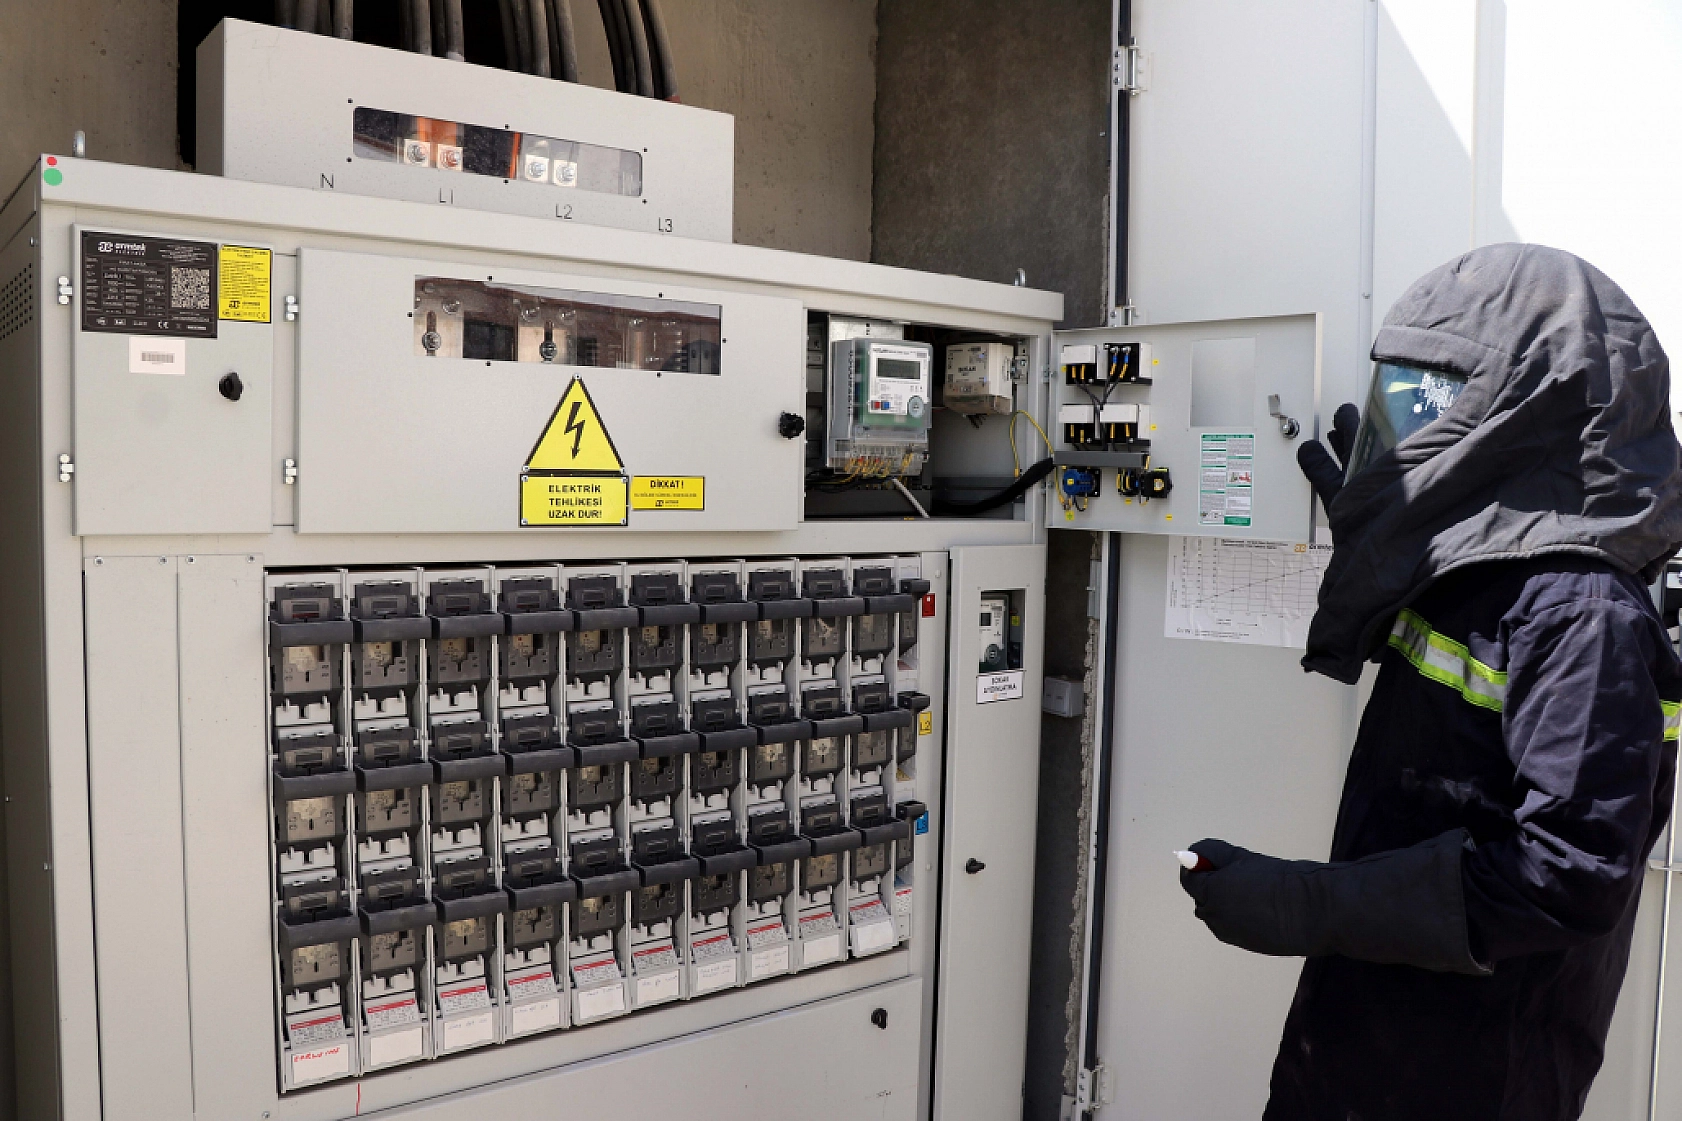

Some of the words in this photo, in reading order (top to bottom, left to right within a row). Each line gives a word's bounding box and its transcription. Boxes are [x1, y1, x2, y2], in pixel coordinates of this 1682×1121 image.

[320, 172, 334, 189] N
[439, 187, 454, 204] L1
[555, 203, 573, 220] L2
[658, 216, 674, 233] L3
[548, 483, 601, 493] ELEKTRİK
[548, 497, 602, 506] TEHLİKESİ
[548, 509, 575, 519] UZAK
[578, 509, 602, 519] DUR!
[919, 719, 931, 731] L2
[916, 819, 927, 831] L3
